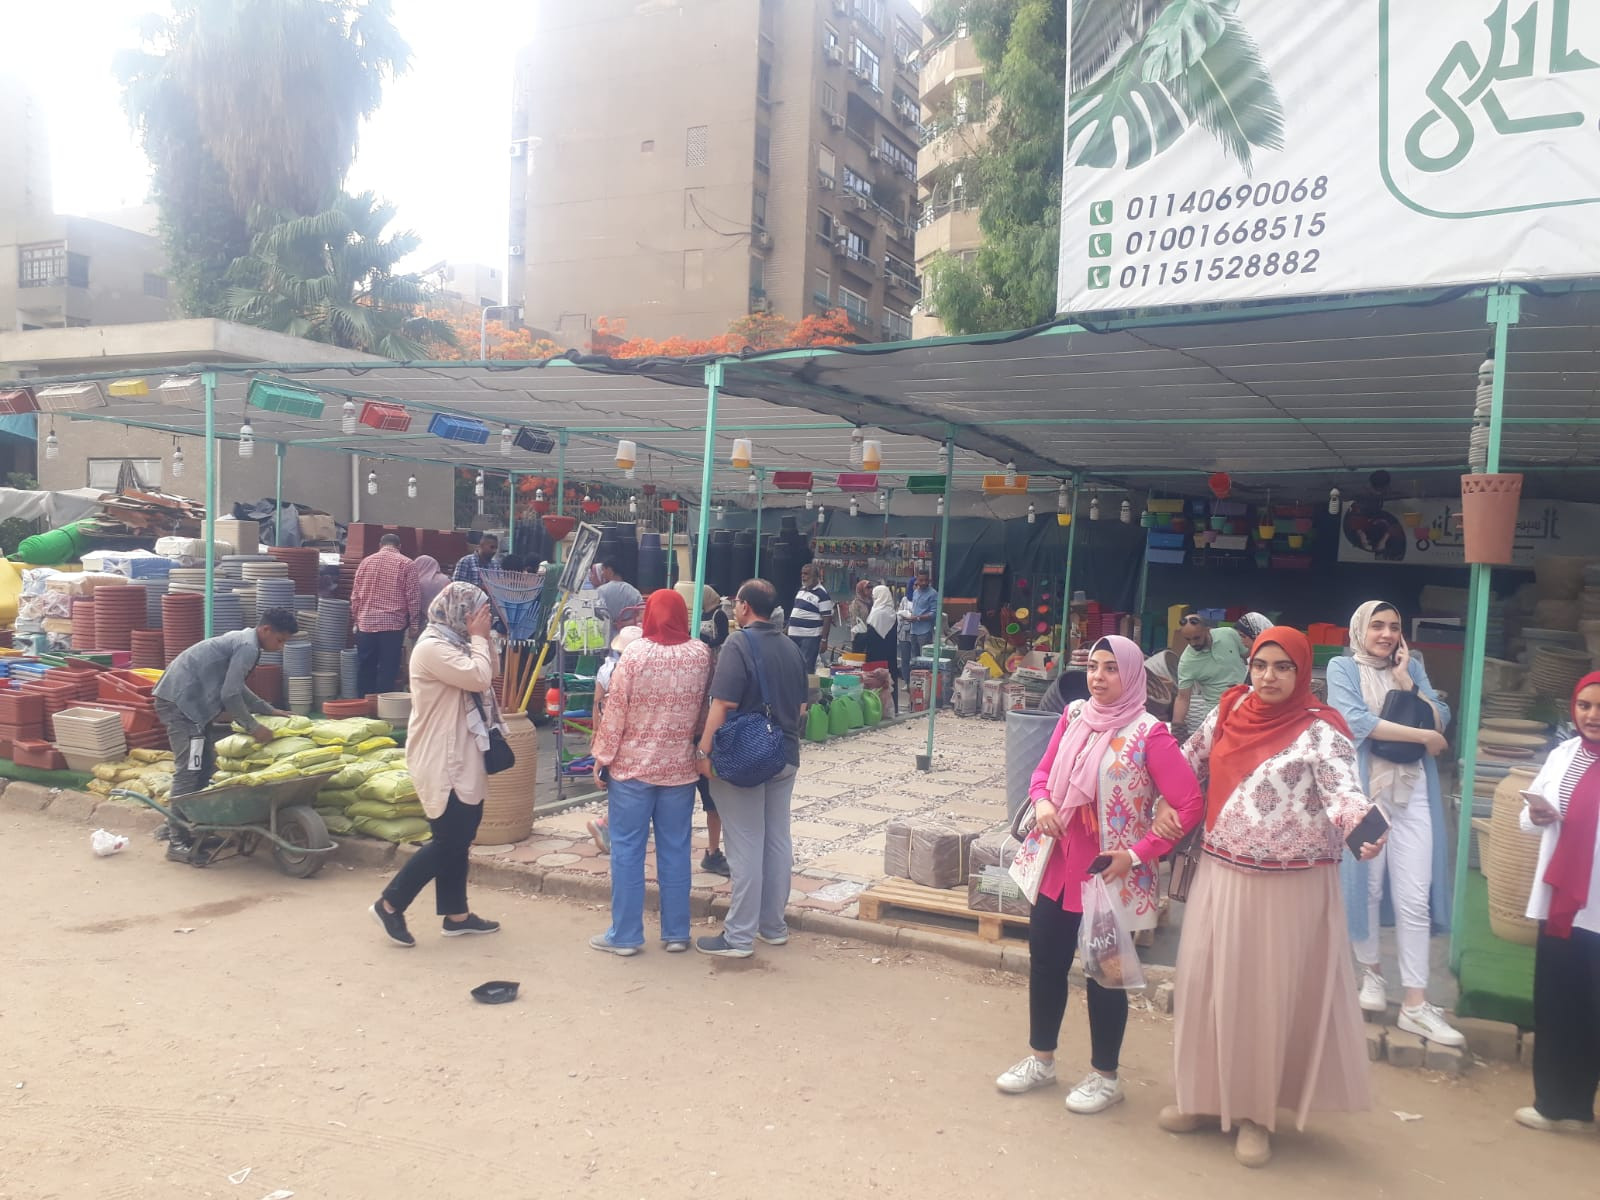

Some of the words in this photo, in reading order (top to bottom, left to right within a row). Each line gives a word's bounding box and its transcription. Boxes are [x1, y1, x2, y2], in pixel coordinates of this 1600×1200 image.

[1127, 175, 1328, 221] 01140690068
[1126, 212, 1326, 255] 01001668515
[1119, 249, 1320, 289] 01151528882
